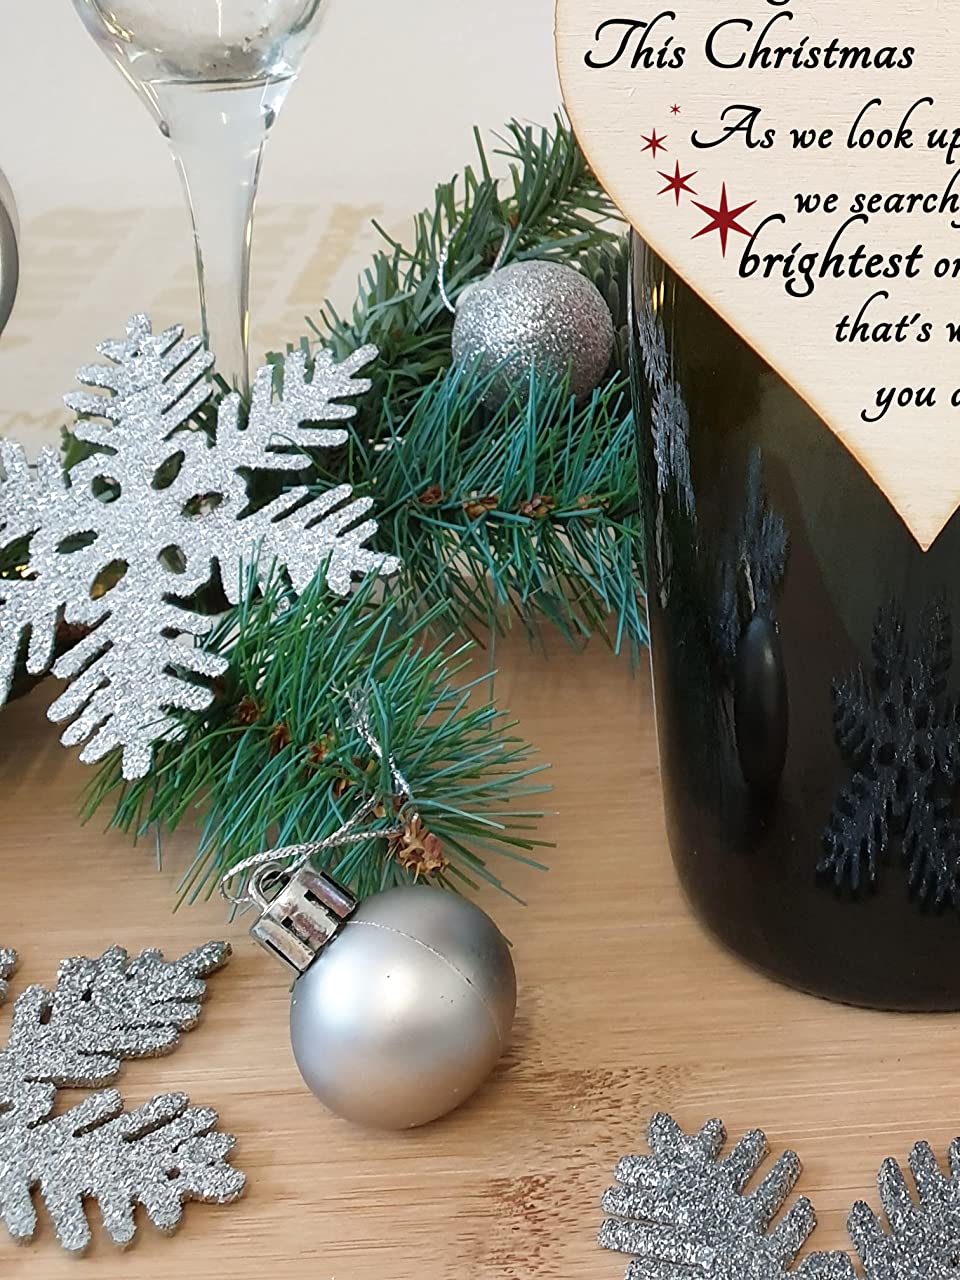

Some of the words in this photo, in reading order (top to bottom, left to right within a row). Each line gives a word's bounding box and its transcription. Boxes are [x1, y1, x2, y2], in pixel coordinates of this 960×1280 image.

[583, 10, 686, 69] This
[704, 10, 915, 69] Christmas
[690, 104, 776, 149] As
[789, 128, 834, 149] we
[846, 96, 934, 149] look
[794, 193, 839, 214] we
[738, 213, 924, 298] brightest
[835, 290, 933, 343] that's
[860, 387, 937, 423] you
